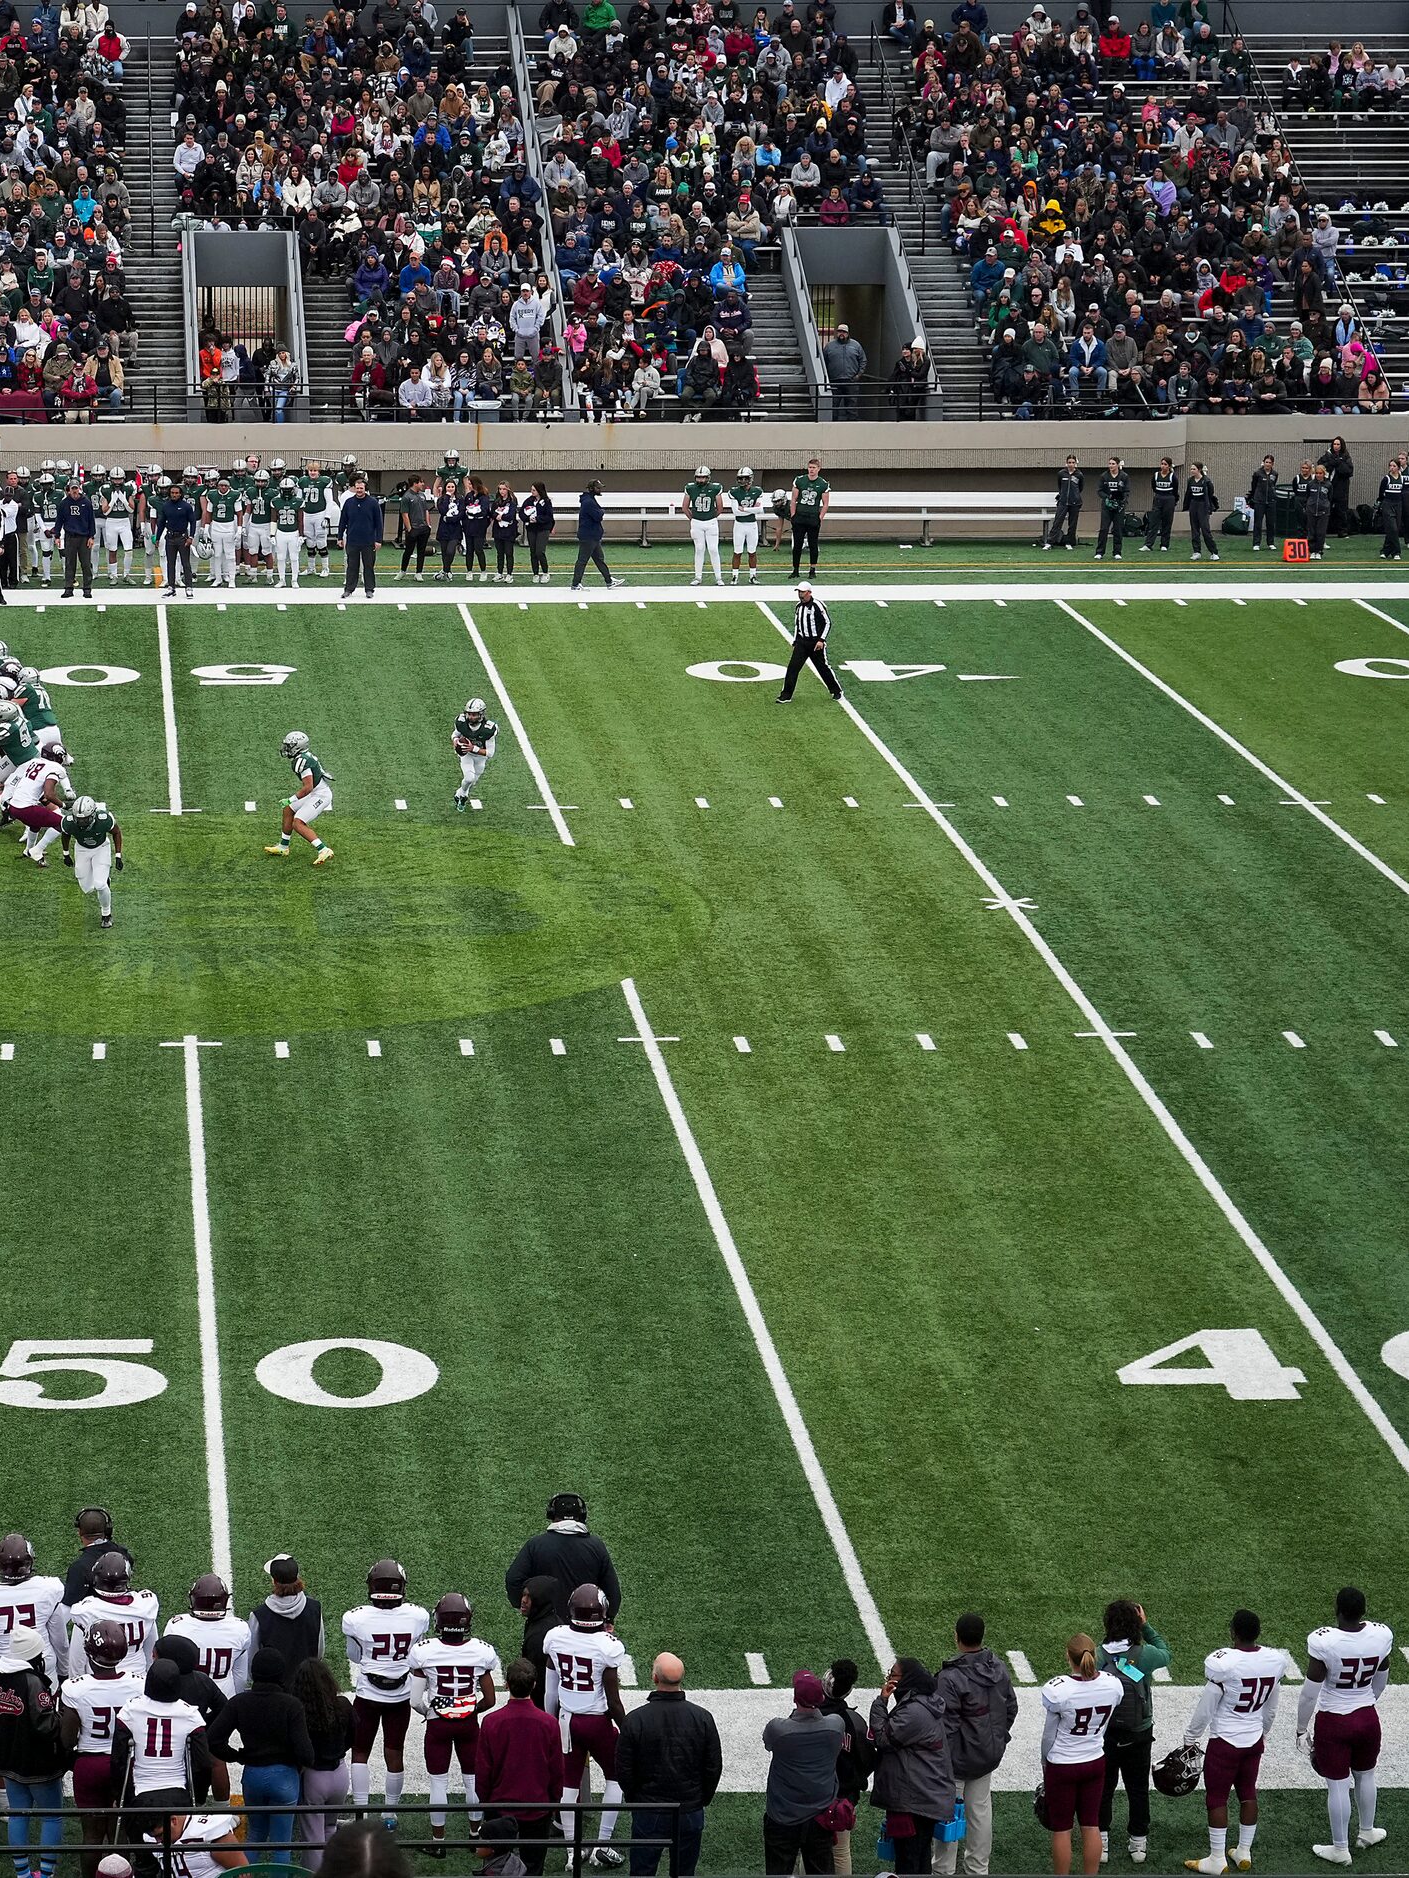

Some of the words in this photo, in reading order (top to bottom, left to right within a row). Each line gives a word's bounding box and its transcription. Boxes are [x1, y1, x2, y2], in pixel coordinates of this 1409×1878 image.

[303, 487, 320, 503] 70
[695, 496, 711, 512] 40
[69, 506, 81, 515] R
[217, 503, 226, 518] 2
[252, 499, 266, 515] 31
[278, 509, 296, 525] 26
[1287, 541, 1307, 559] 30
[26, 760, 46, 781] 48
[92, 1631, 105, 1648] 35
[371, 1633, 413, 1662] 28
[436, 1665, 475, 1697] 23
[556, 1652, 595, 1692] 83
[1335, 1655, 1380, 1690] 32
[1233, 1676, 1276, 1714] 30
[1070, 1705, 1113, 1736] 87
[144, 1717, 173, 1758] 11
